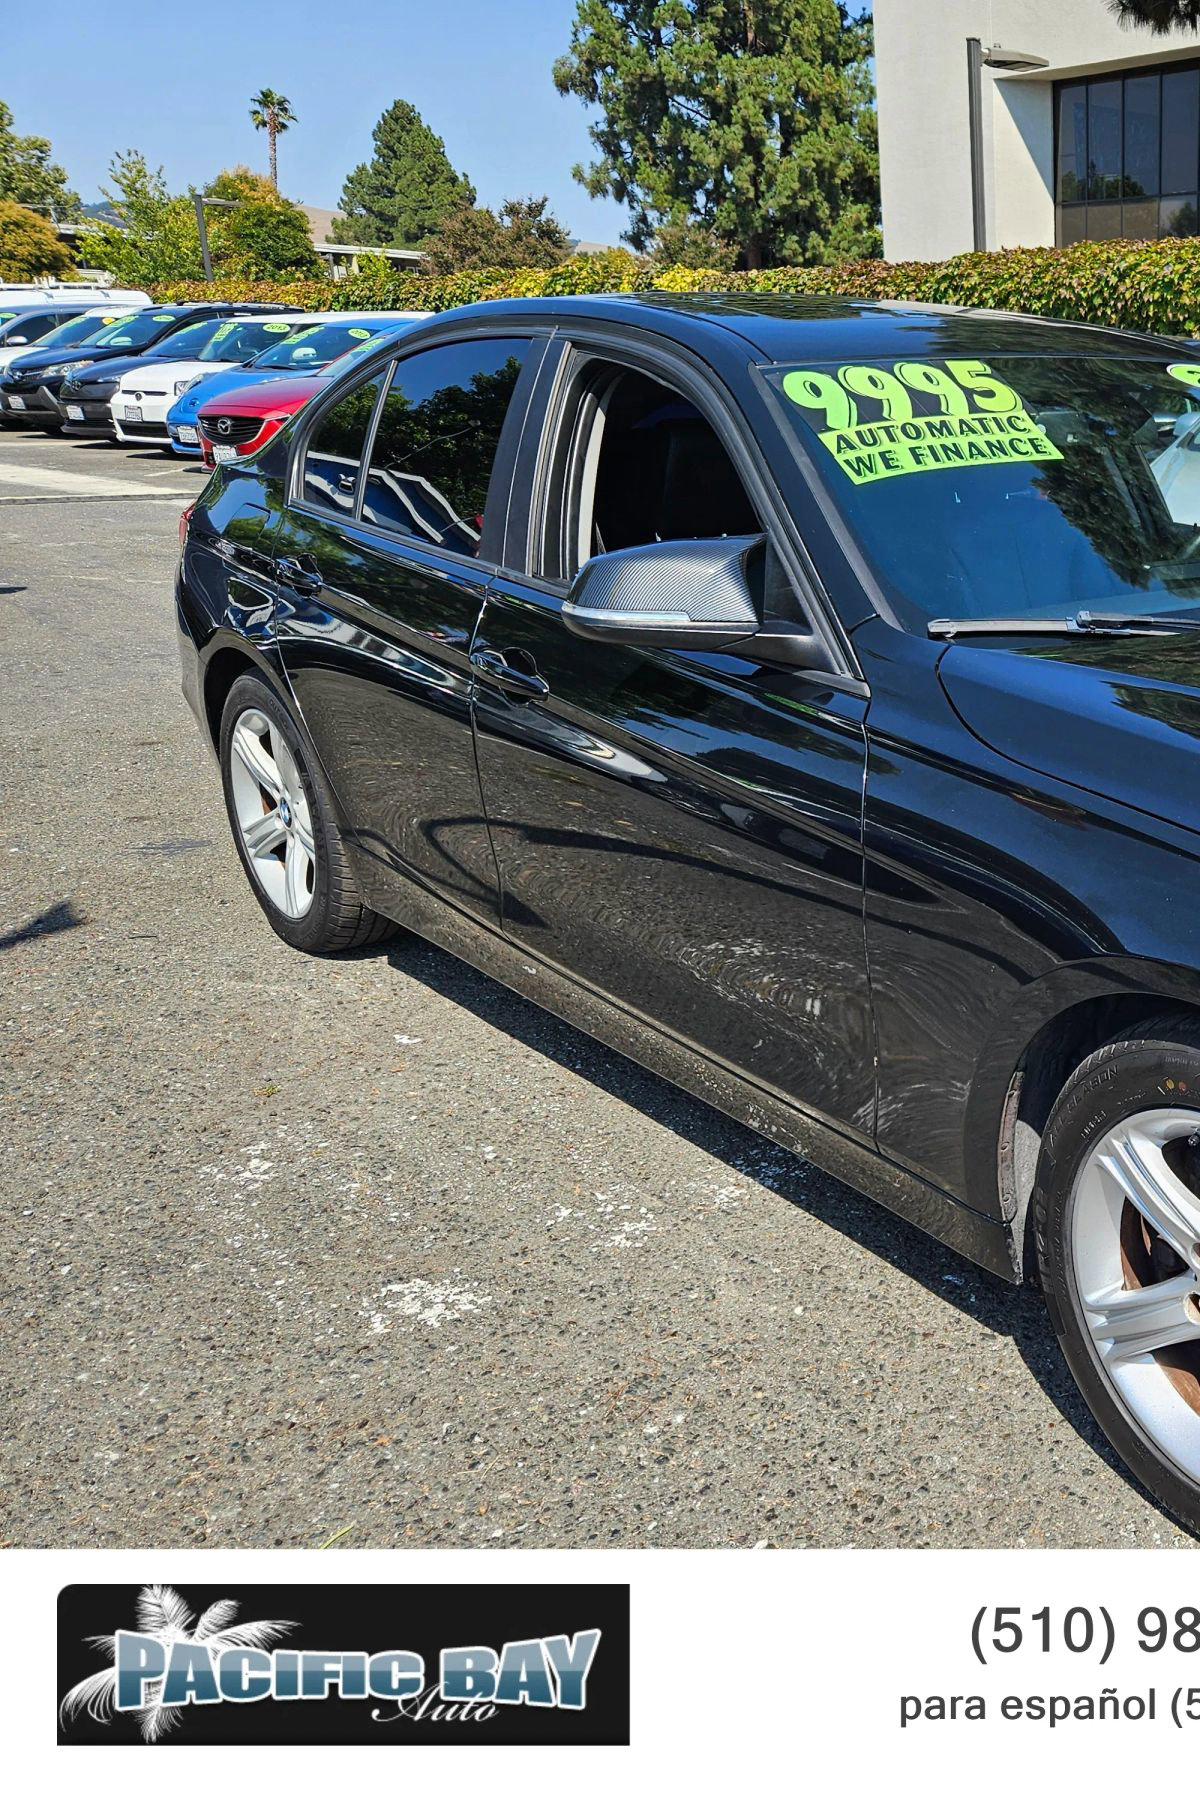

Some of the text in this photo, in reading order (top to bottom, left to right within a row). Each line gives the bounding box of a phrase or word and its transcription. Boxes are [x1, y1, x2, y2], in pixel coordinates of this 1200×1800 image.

[782, 360, 1023, 430] 9995
[836, 415, 1029, 454] AUTOMATIC
[843, 437, 1051, 477] WE FINANCE
